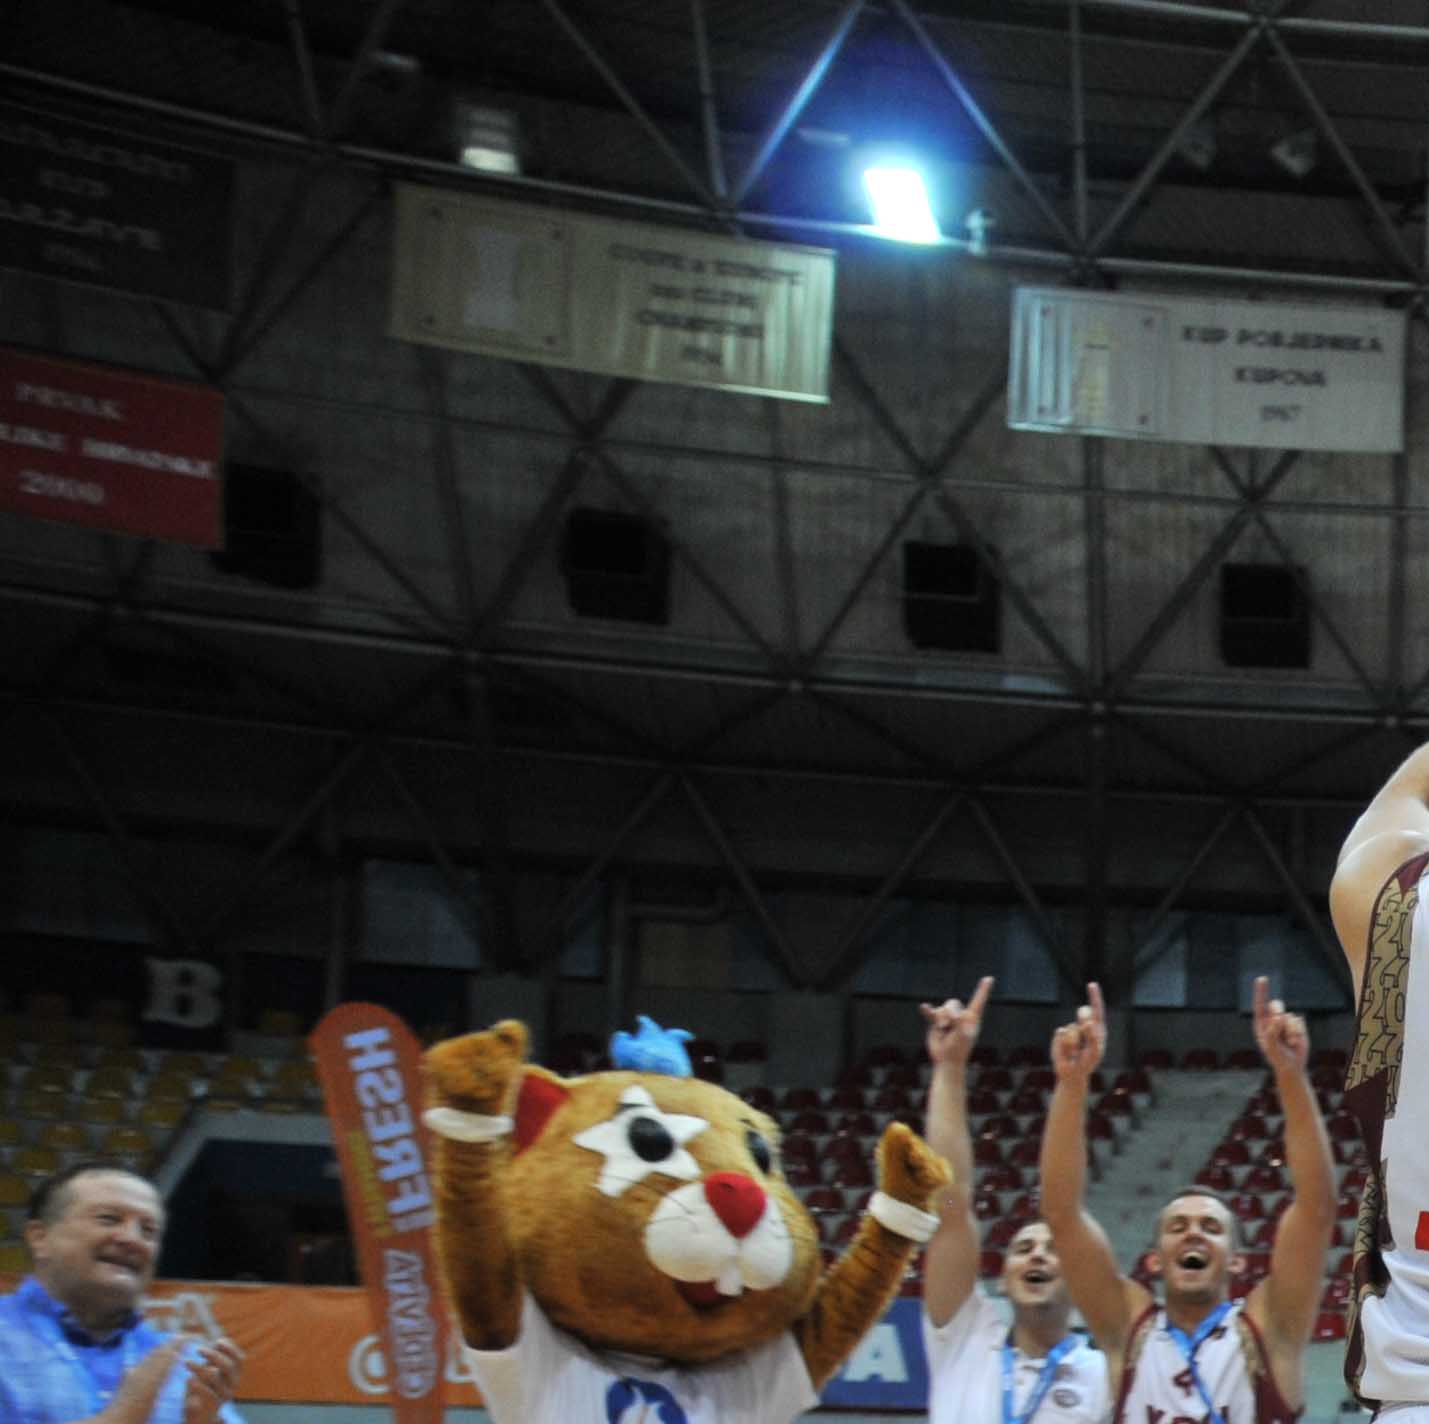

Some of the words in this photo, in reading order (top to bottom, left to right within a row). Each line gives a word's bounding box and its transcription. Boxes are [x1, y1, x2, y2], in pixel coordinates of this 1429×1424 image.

[1182, 327, 1228, 343] KUP
[143, 956, 222, 1028] B
[843, 1322, 910, 1383] A
